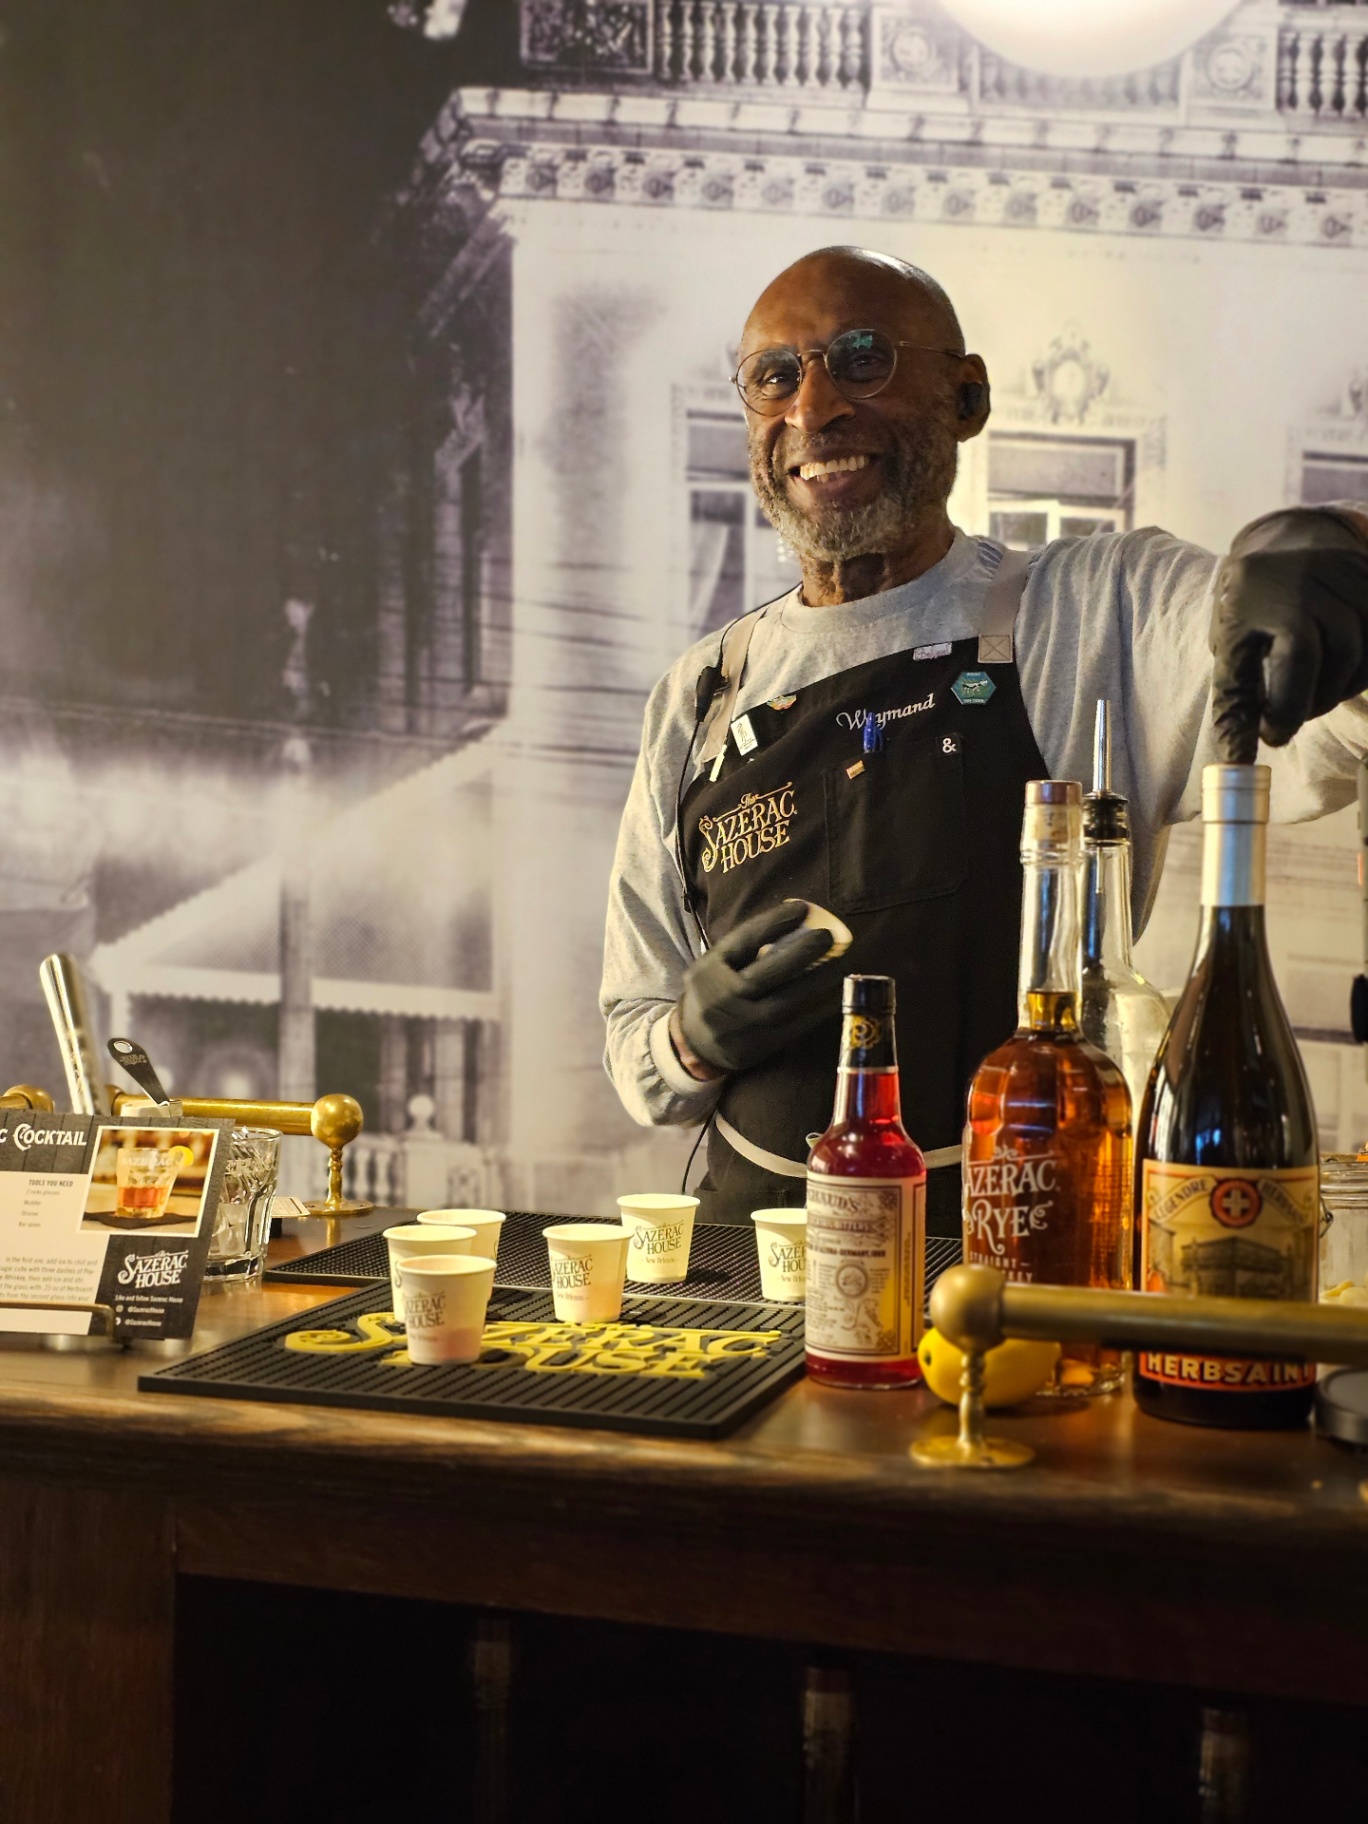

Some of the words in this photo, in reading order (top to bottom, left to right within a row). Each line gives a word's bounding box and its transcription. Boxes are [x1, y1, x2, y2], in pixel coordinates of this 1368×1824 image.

[836, 692, 936, 731] Wymand
[942, 737, 958, 754] &
[699, 790, 796, 873] SAZERAC
[721, 820, 790, 874] HOUSE
[12, 1123, 88, 1152] COCKTAIL
[29, 1179, 46, 1187] TOOLS
[633, 1222, 685, 1250] SAZERAC
[972, 1198, 1031, 1256] RYE
[647, 1236, 682, 1255] HOUSE
[768, 1242, 805, 1268] SAZE
[117, 1253, 189, 1285] SAZERAC
[135, 1268, 182, 1289] HOUSE
[556, 1273, 592, 1289] HOUSE
[284, 1311, 779, 1357] SZERAC
[405, 1311, 445, 1329] HOUSE
[381, 1346, 723, 1378] OUSE
